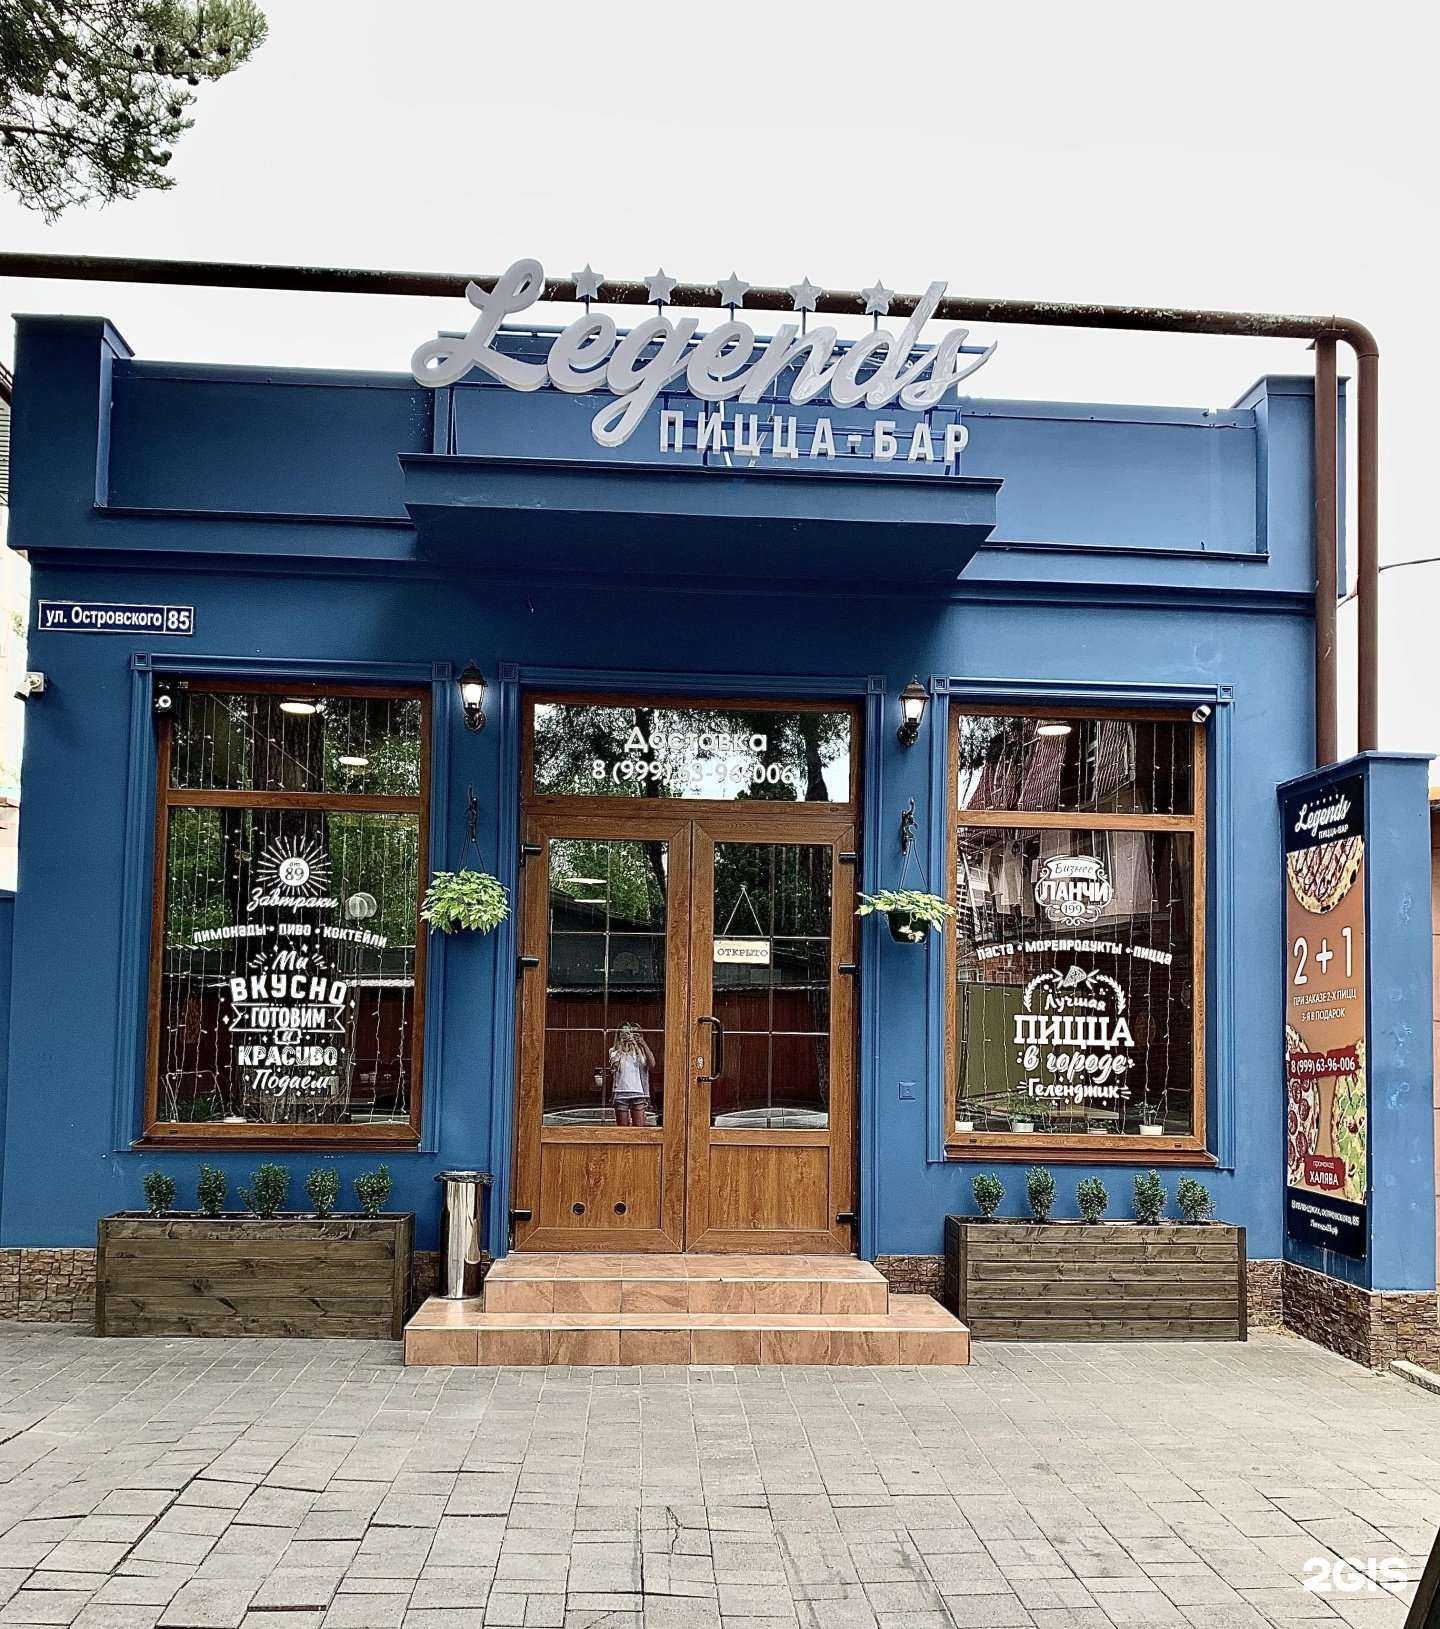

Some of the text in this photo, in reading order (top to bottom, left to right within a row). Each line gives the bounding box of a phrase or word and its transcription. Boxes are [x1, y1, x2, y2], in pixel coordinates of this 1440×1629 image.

[410, 258, 997, 448] Legends
[660, 410, 970, 463] ПИЦЦА-БАР
[46, 606, 190, 629] ул. Островского 85
[624, 726, 767, 753] Доставка
[592, 759, 606, 780] 8
[612, 759, 671, 784] (999)
[1294, 794, 1351, 837] Legends
[1318, 824, 1349, 839] ПИЦЦА-БАР
[285, 867, 304, 880] 89
[1054, 862, 1093, 876] Бизнес
[246, 887, 339, 914] Завтраки
[1039, 881, 1110, 902] ЛАНЧИ
[1064, 904, 1083, 914] 199
[717, 948, 768, 957] ОТКРЫТО
[230, 974, 347, 1005] ВКУСНО
[1293, 996, 1304, 1006] ПРИ
[1305, 992, 1326, 1004] ЗАКАЗЕ
[1337, 988, 1357, 1000] ПИЦЦ
[1044, 994, 1106, 1012] Лучшая
[251, 1007, 325, 1028] ГОТОВИМ
[1315, 1008, 1345, 1021] ПОДАРОК
[1013, 1015, 1135, 1050] ПИЦЦА
[238, 1046, 337, 1066] КРАСИВО
[1023, 1045, 1127, 1084] в городе
[1291, 1057, 1355, 1075] 8 (999) 63-96-006
[252, 1069, 330, 1096] Подаём
[1028, 1078, 1120, 1104] Геленджик
[1309, 1170, 1339, 1186] ХАЛЯВА
